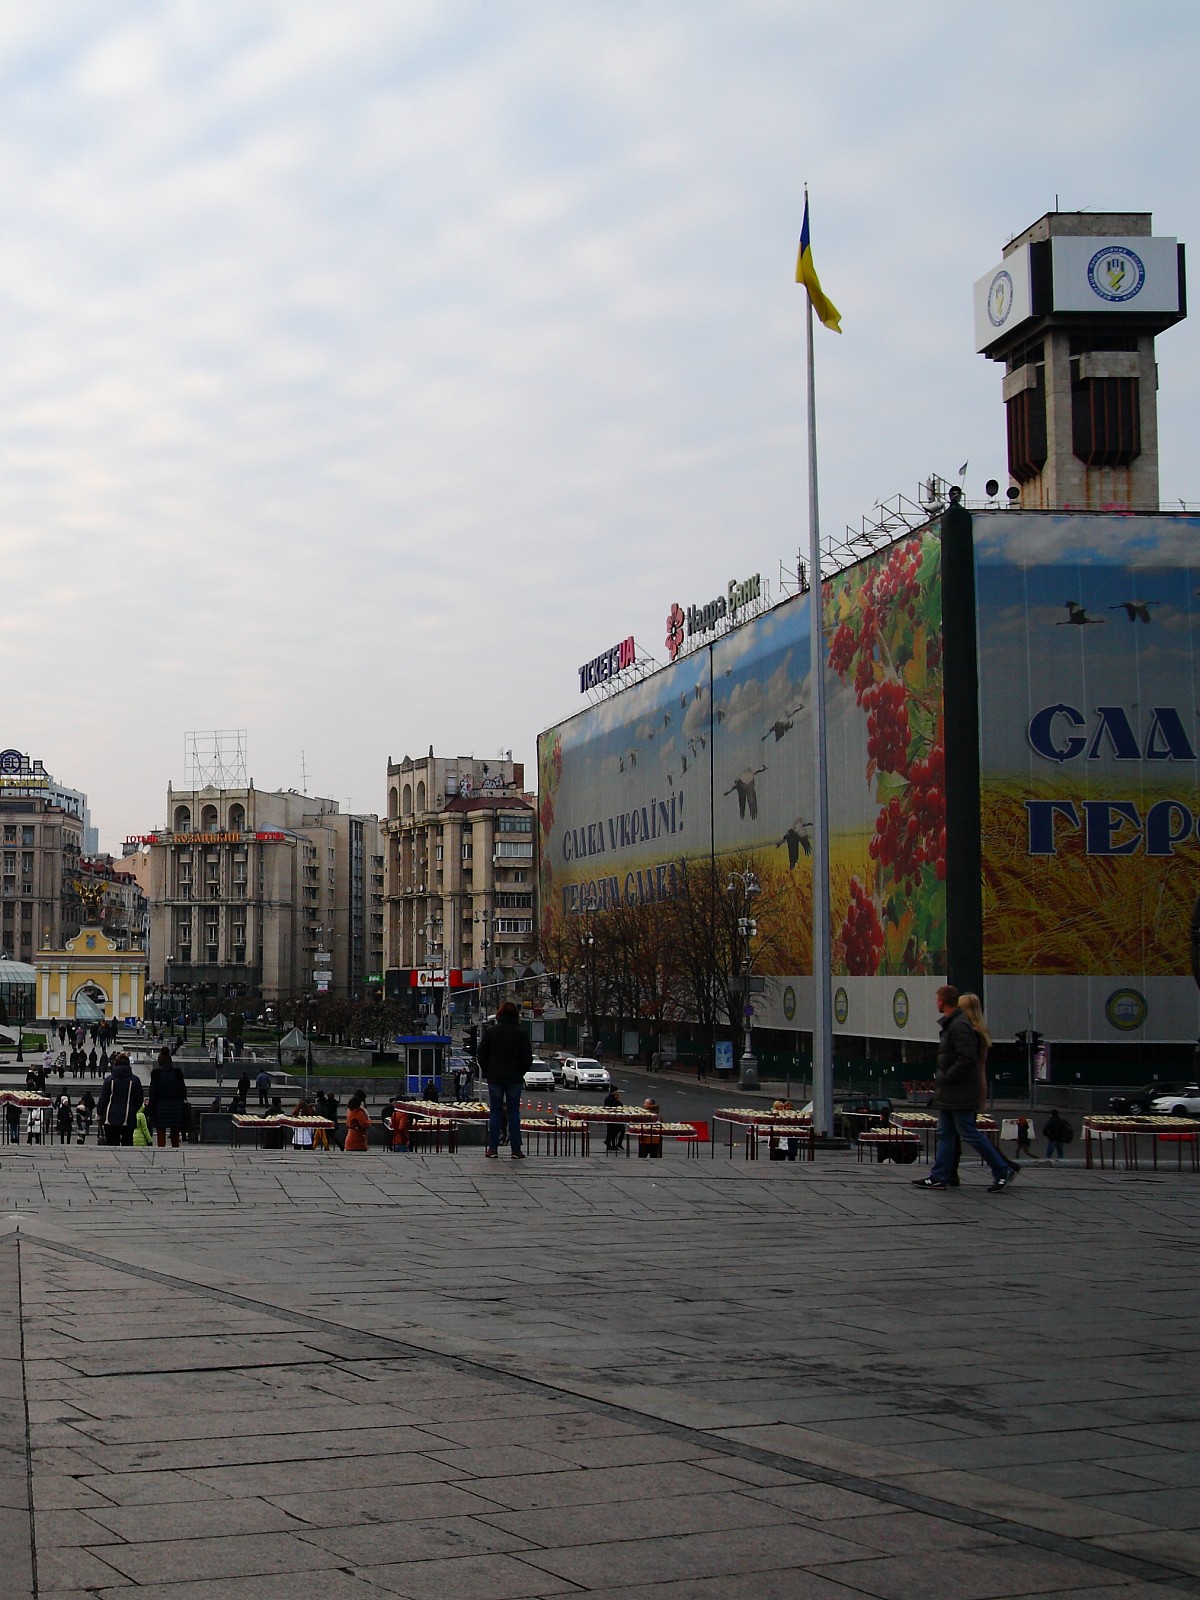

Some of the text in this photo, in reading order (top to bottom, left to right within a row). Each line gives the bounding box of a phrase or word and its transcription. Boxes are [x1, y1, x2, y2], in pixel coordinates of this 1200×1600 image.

[687, 573, 760, 637] Надра Банк
[173, 832, 242, 844] КОЗАЦЬКИЙ
[1024, 800, 1200, 856] ГЕР
